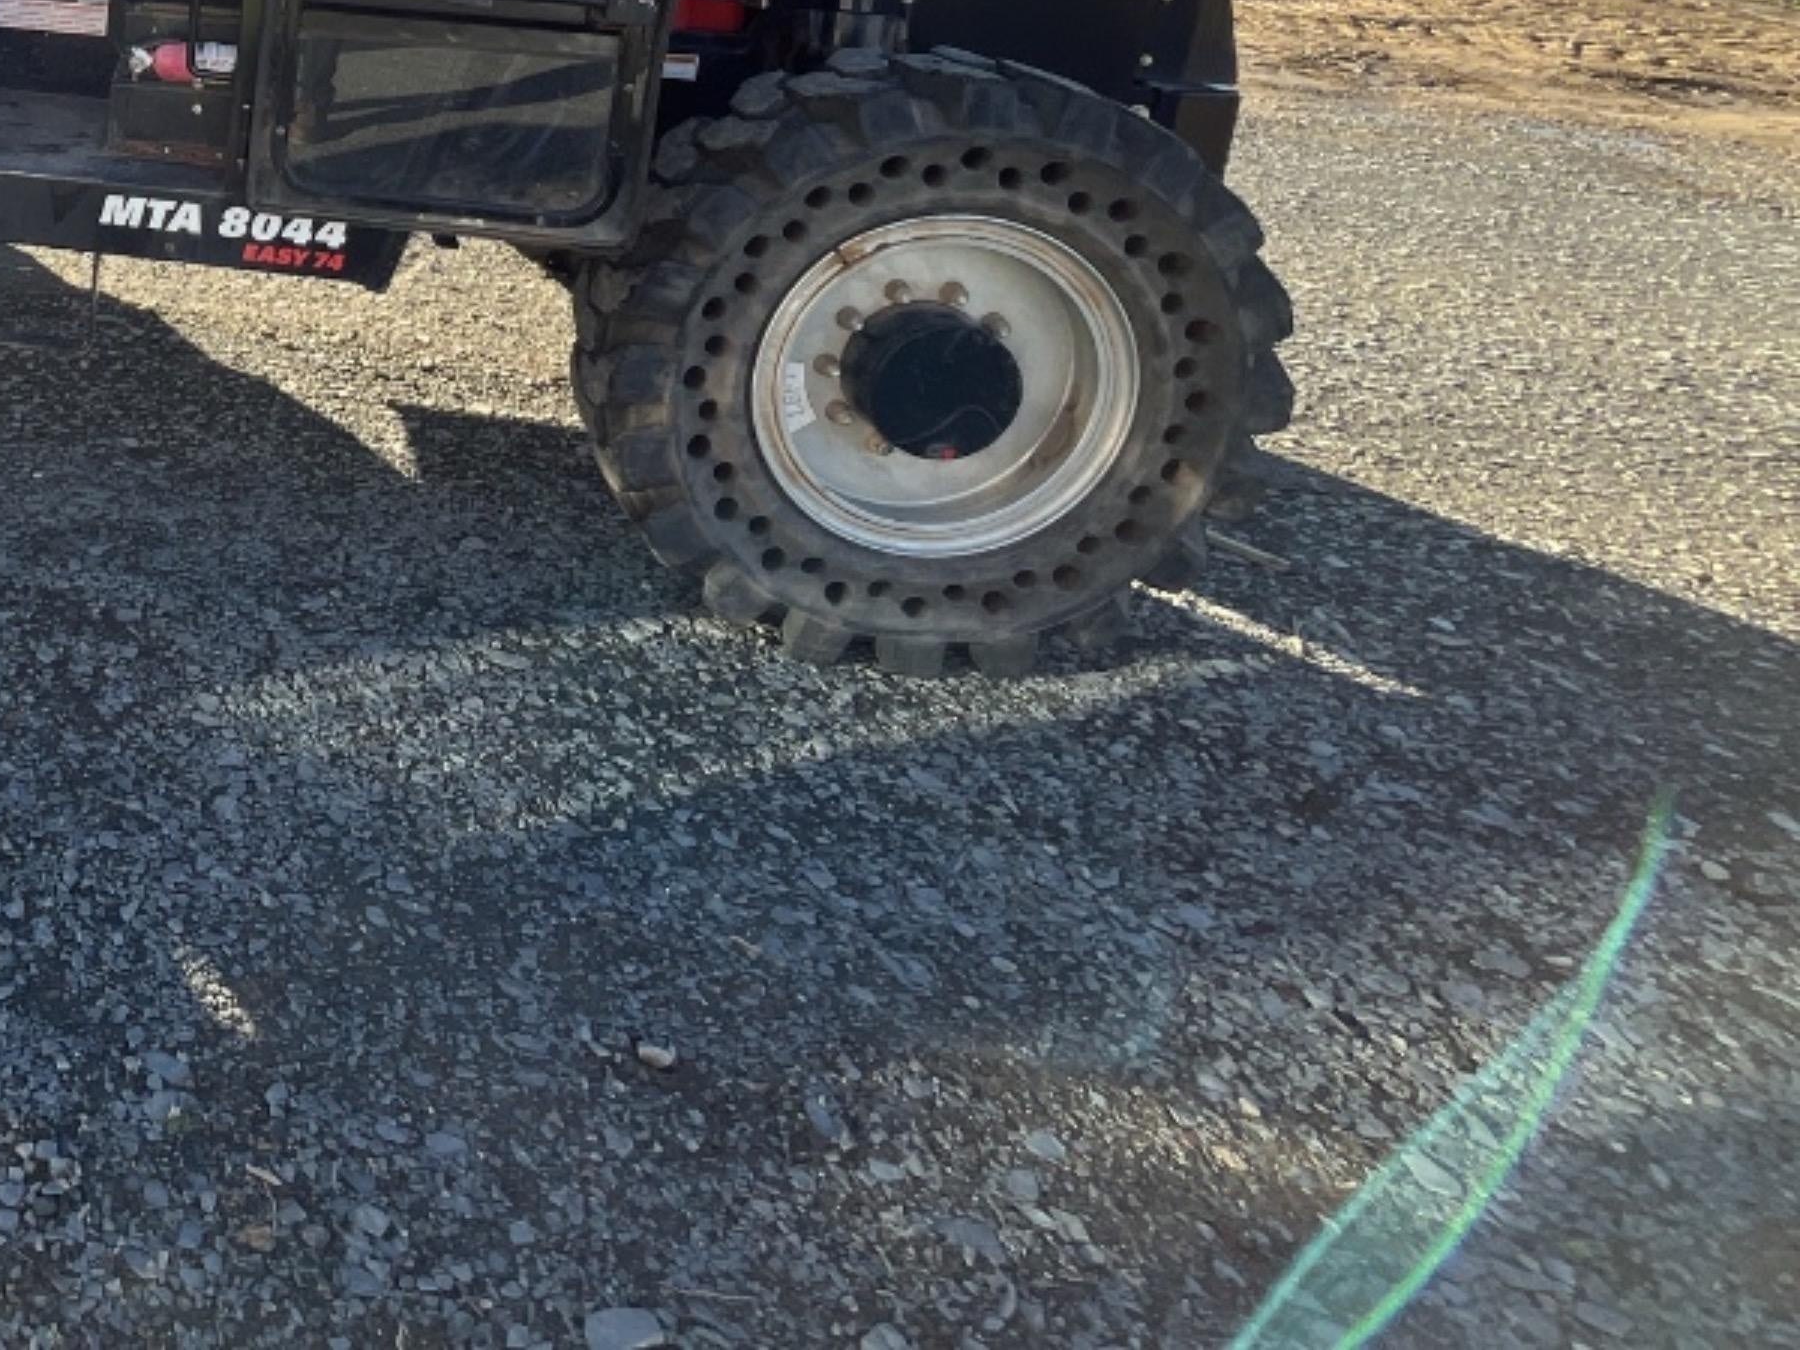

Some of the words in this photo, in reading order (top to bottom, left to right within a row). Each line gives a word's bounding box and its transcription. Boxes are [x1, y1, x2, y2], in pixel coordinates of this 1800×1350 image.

[98, 193, 203, 235] MTA
[217, 205, 348, 250] 8044
[241, 241, 309, 268] EASY
[312, 251, 347, 272] 74
